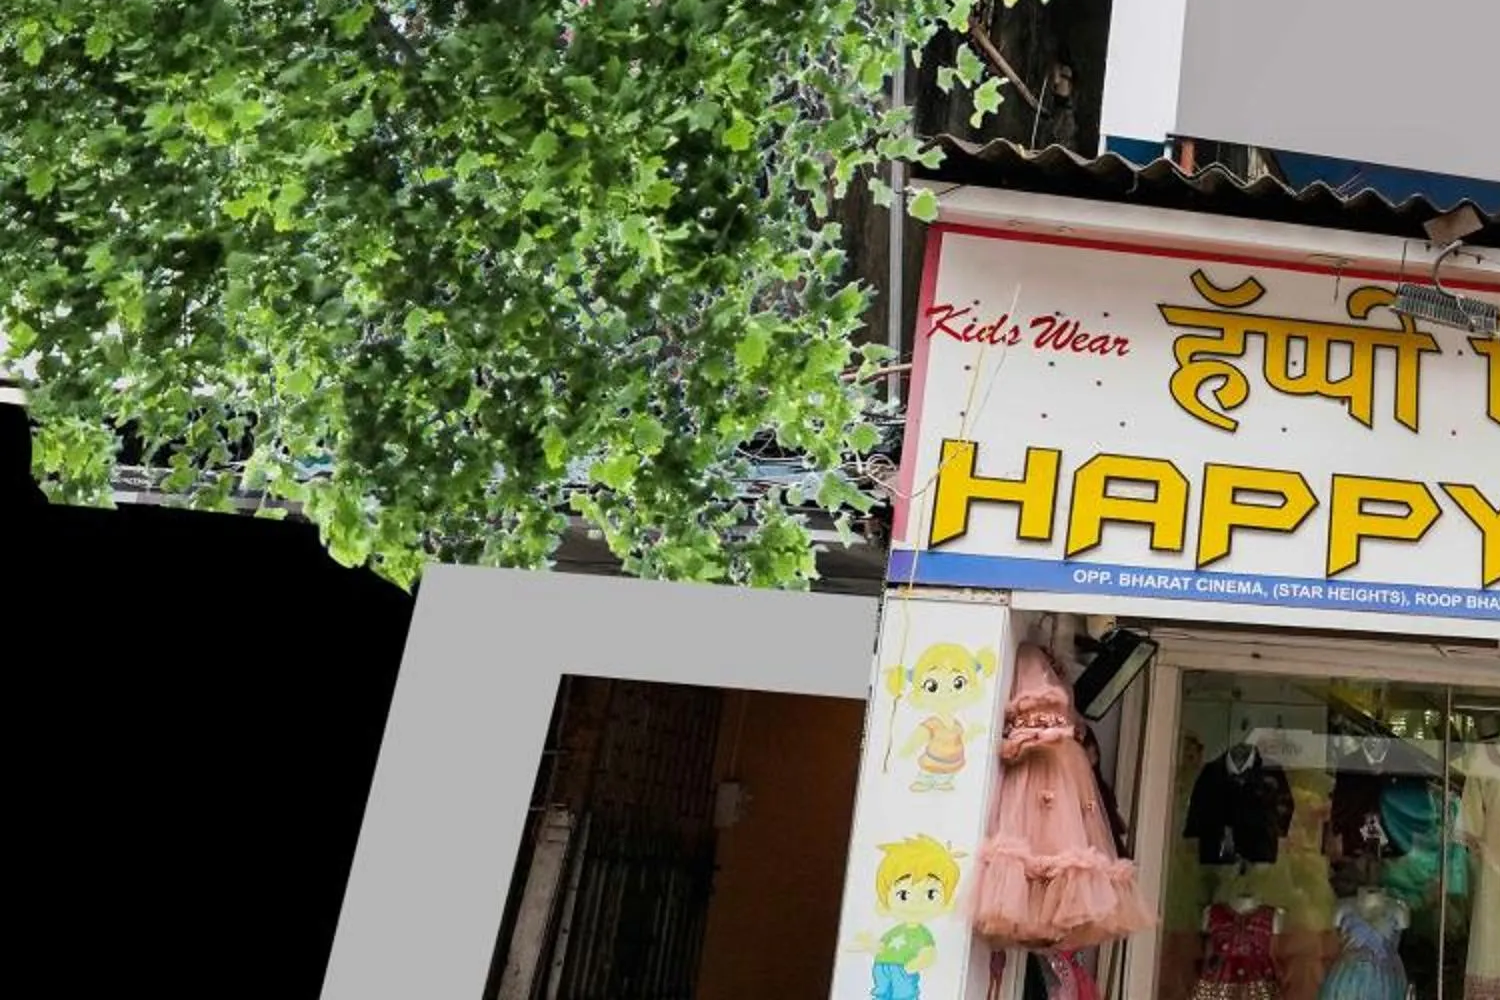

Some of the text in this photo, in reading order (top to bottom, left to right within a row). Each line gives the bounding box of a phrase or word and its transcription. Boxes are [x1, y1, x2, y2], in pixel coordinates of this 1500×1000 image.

[925, 304, 1130, 357] Kids Wear
[1073, 569, 1112, 585] OPP.
[1119, 573, 1189, 591] BHARAT
[1196, 577, 1267, 597] CINEMA,
[1273, 581, 1323, 600] (STAR
[1328, 586, 1410, 606] HEIGHTS),
[1416, 592, 1461, 607] ROOP
